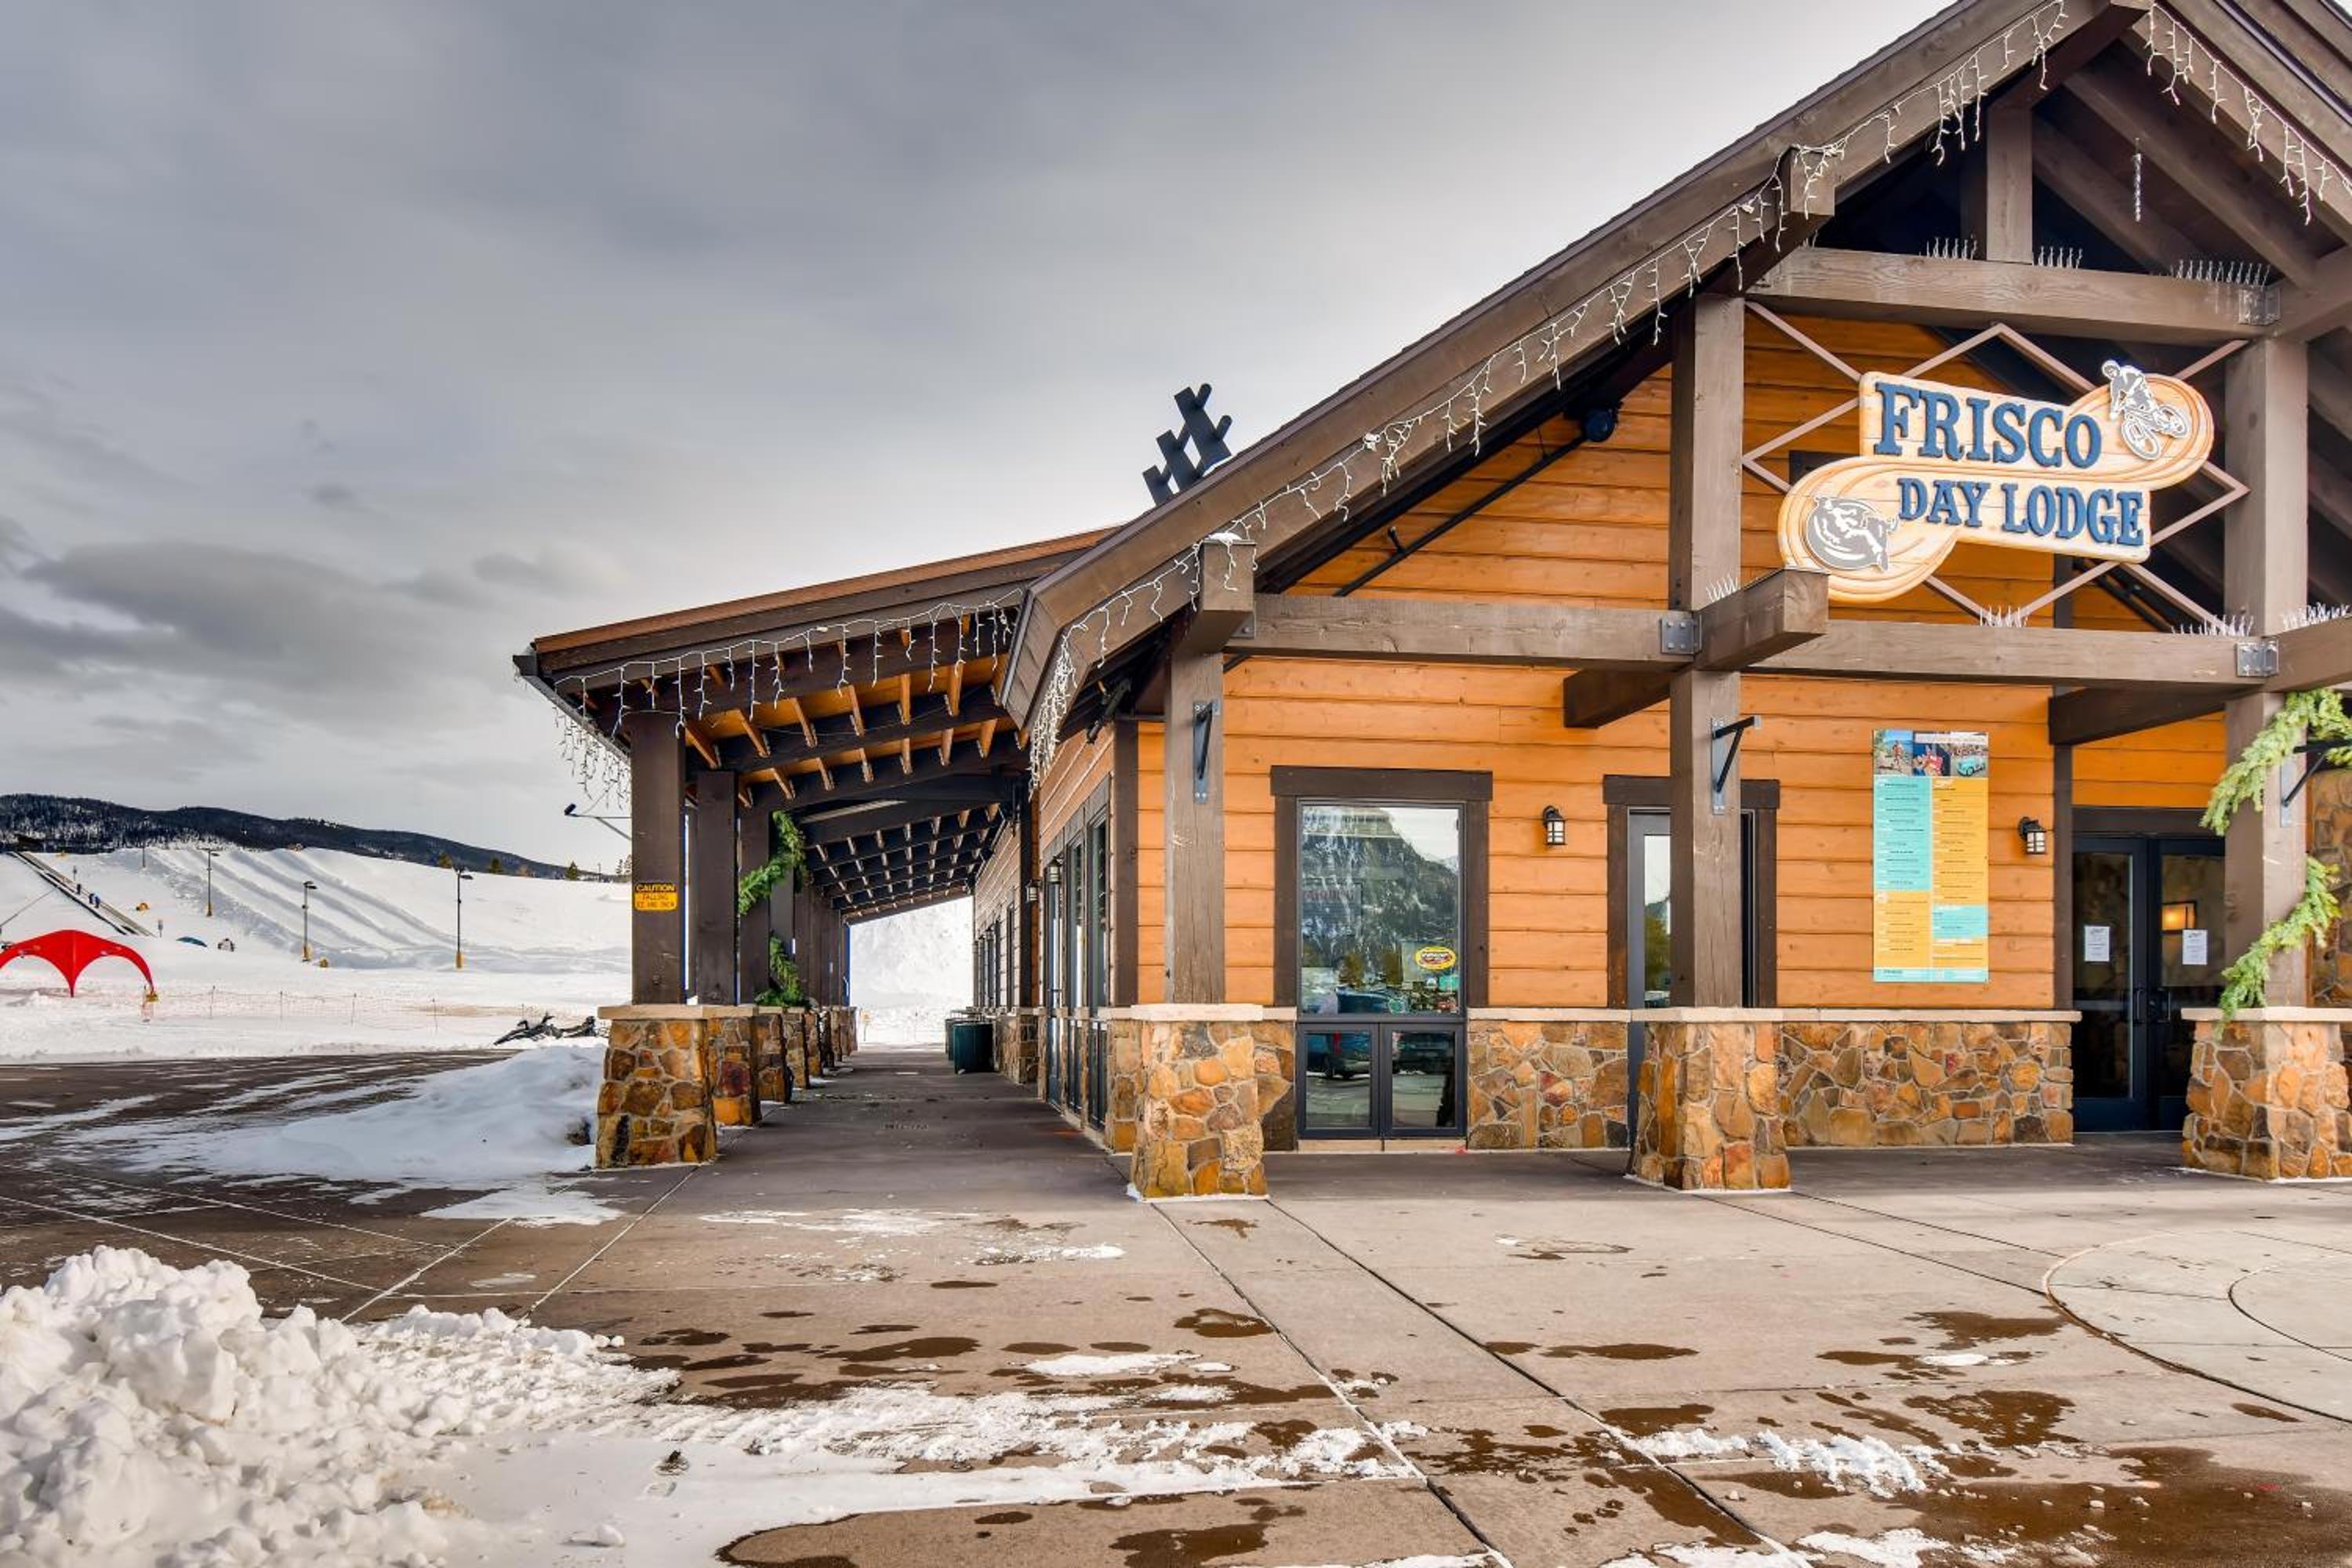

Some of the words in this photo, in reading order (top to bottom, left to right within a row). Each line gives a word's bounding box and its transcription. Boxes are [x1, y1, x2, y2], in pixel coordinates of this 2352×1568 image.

[1874, 381, 2103, 469] FRISCO
[1898, 477, 1991, 528] DAY
[2002, 483, 2144, 546] LODGE
